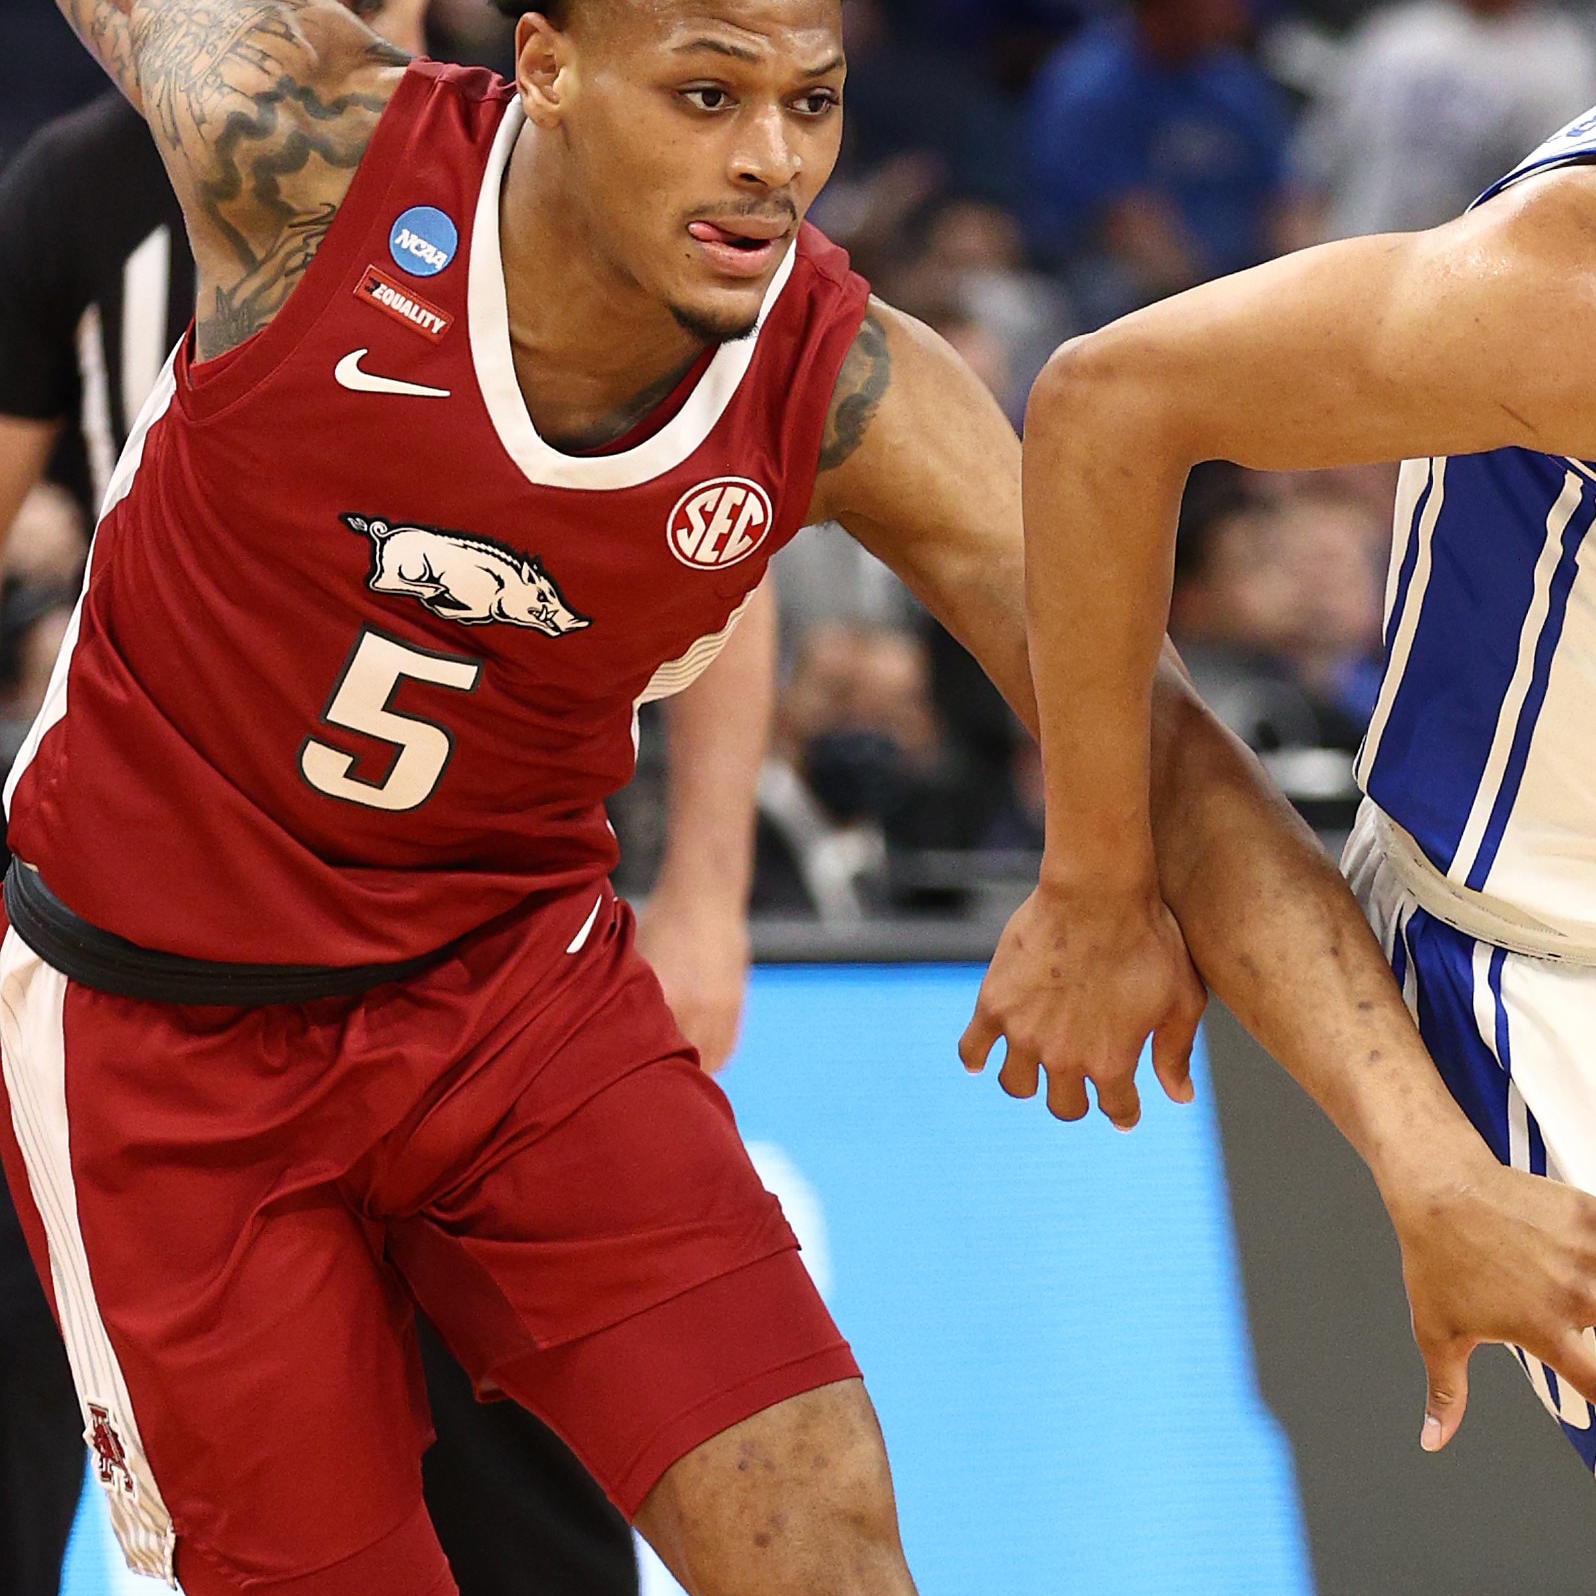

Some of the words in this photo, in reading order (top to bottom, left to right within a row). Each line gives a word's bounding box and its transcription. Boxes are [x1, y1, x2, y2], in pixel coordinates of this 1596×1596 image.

[395, 228, 448, 270] NCAA
[372, 283, 446, 334] EQUALITY
[676, 485, 764, 564] SEC
[299, 625, 482, 812] 5
